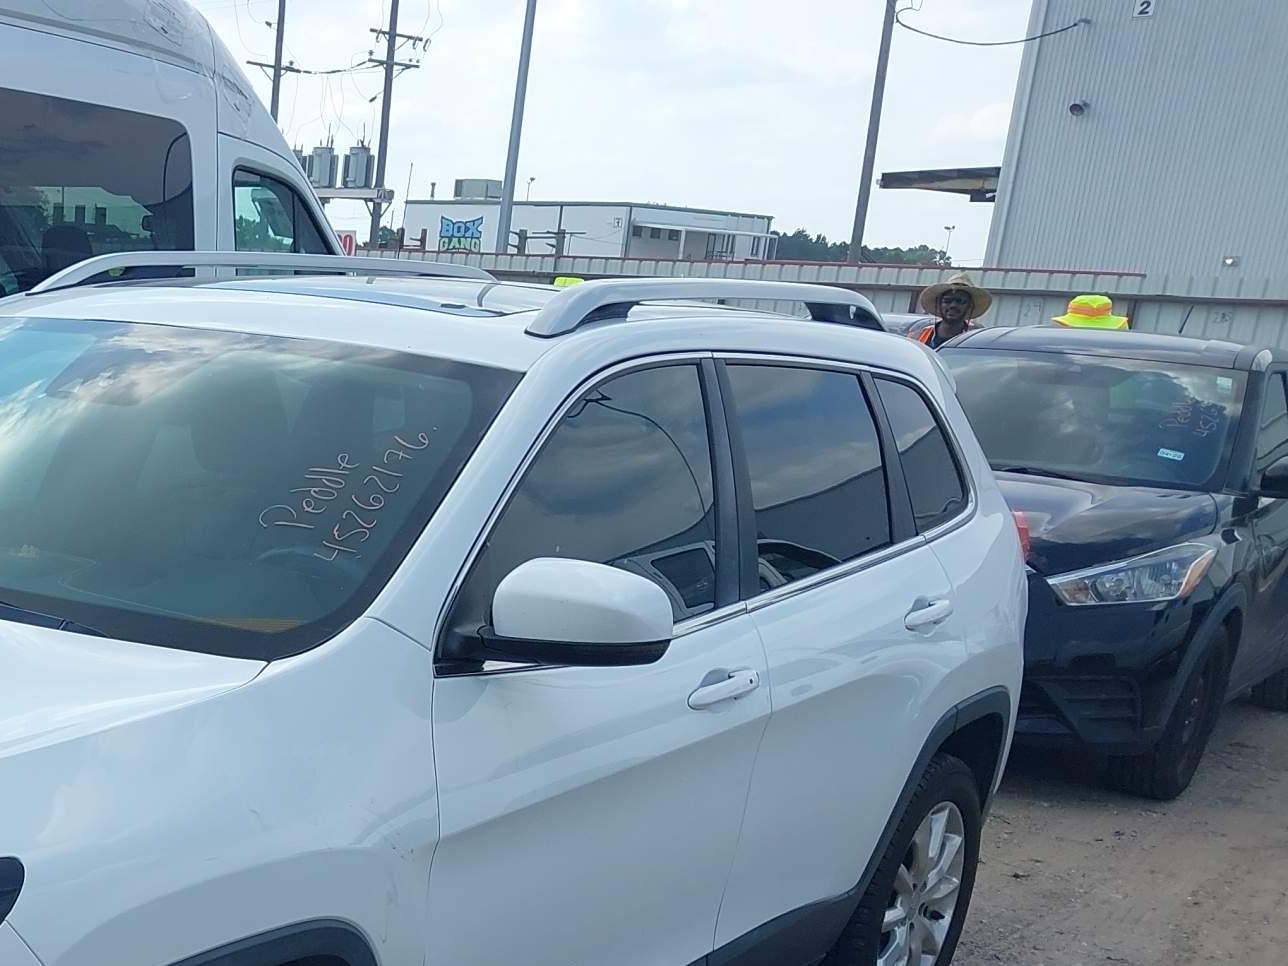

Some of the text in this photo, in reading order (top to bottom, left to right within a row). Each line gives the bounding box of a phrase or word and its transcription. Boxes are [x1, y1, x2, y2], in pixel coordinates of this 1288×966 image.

[1137, 0, 1152, 16] 2
[440, 215, 484, 238] BOX
[259, 453, 360, 529] Peddle
[313, 432, 429, 561] 45262176
